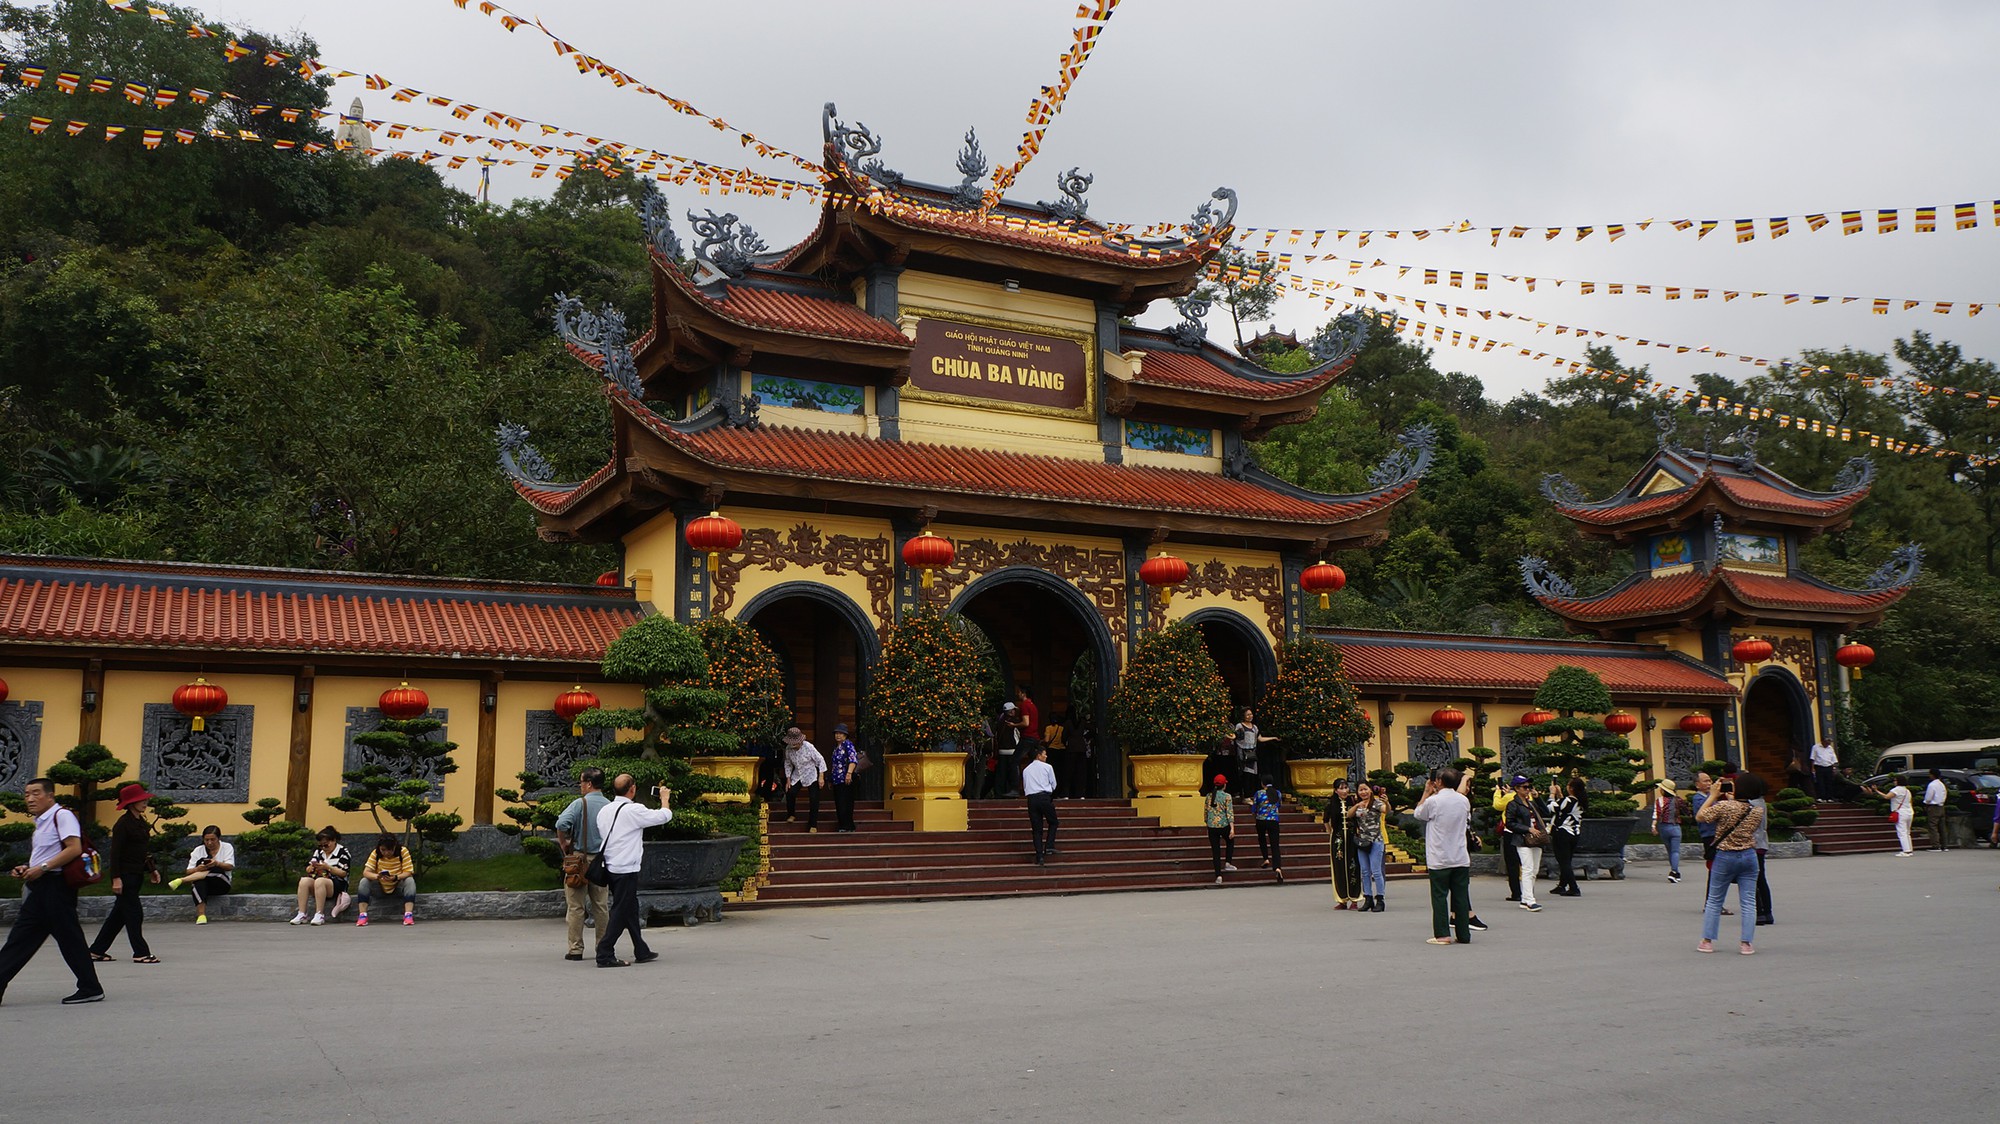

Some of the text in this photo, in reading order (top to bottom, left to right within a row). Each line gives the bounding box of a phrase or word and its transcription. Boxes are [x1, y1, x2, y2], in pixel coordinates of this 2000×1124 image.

[945, 330, 1051, 352] GIÁO HỘI PHẬT GIÁO VIỆT NAM
[967, 343, 1028, 359] TỈNH QUẢNG NINH
[932, 355, 1065, 391] CHÙA BA VÀNG
